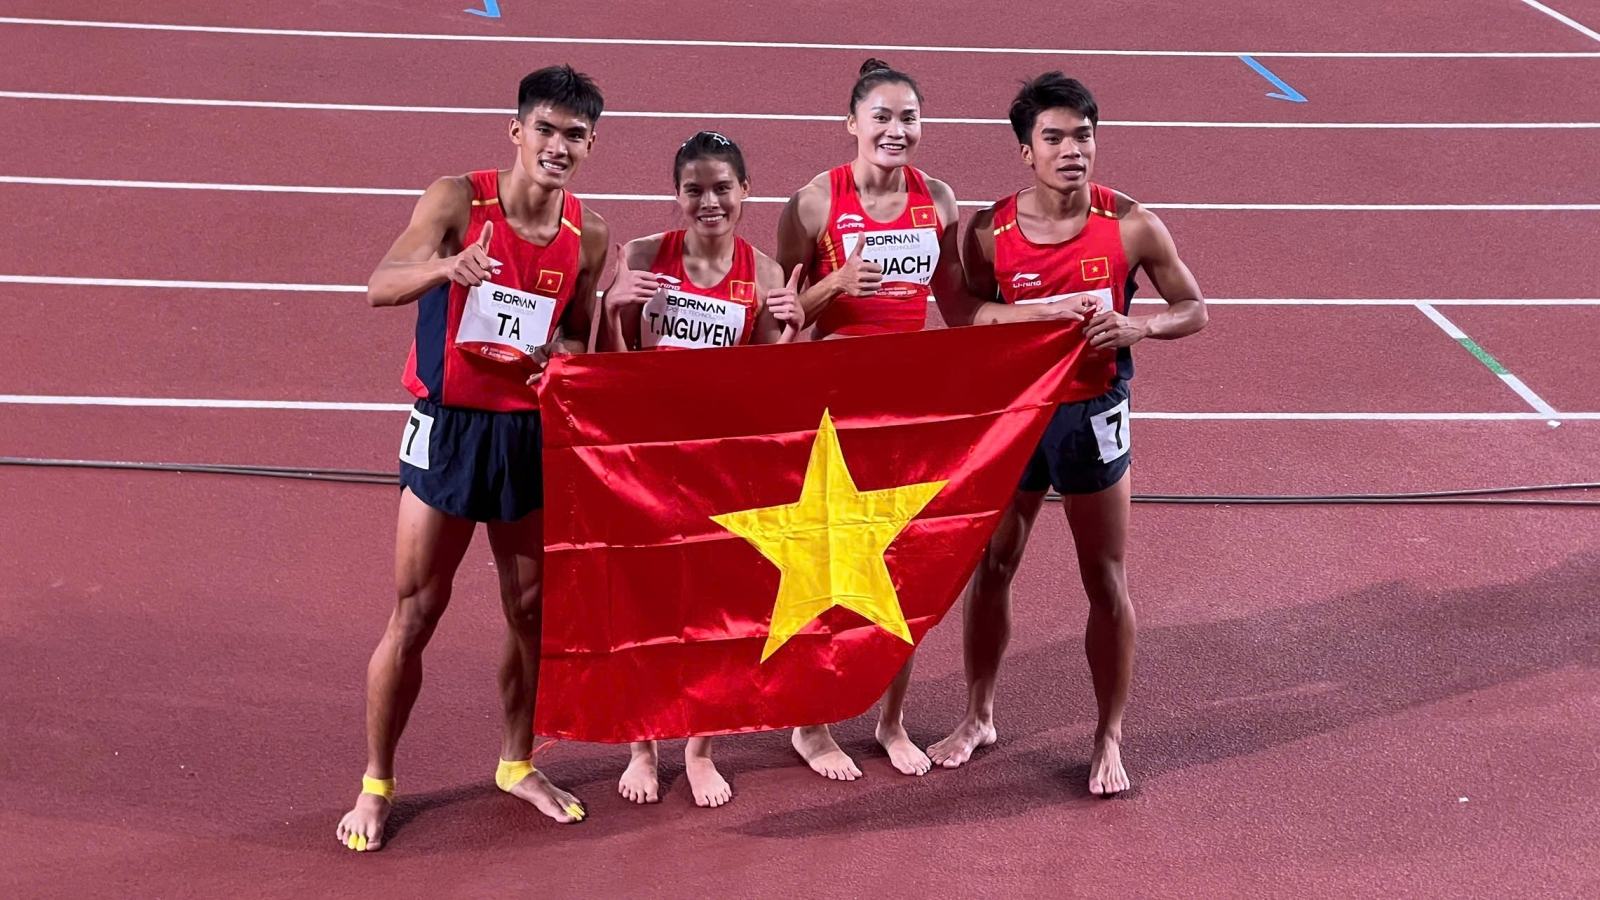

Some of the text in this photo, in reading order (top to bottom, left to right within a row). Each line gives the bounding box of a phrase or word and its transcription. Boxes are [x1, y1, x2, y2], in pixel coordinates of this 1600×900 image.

[866, 233, 920, 246] BORNAN
[1013, 280, 1042, 288] LI-NING
[666, 295, 726, 315] BORNAN
[497, 312, 520, 340] TA
[650, 312, 737, 347] T.NGUYEN
[405, 415, 420, 456] 7
[1105, 410, 1123, 450] 7
